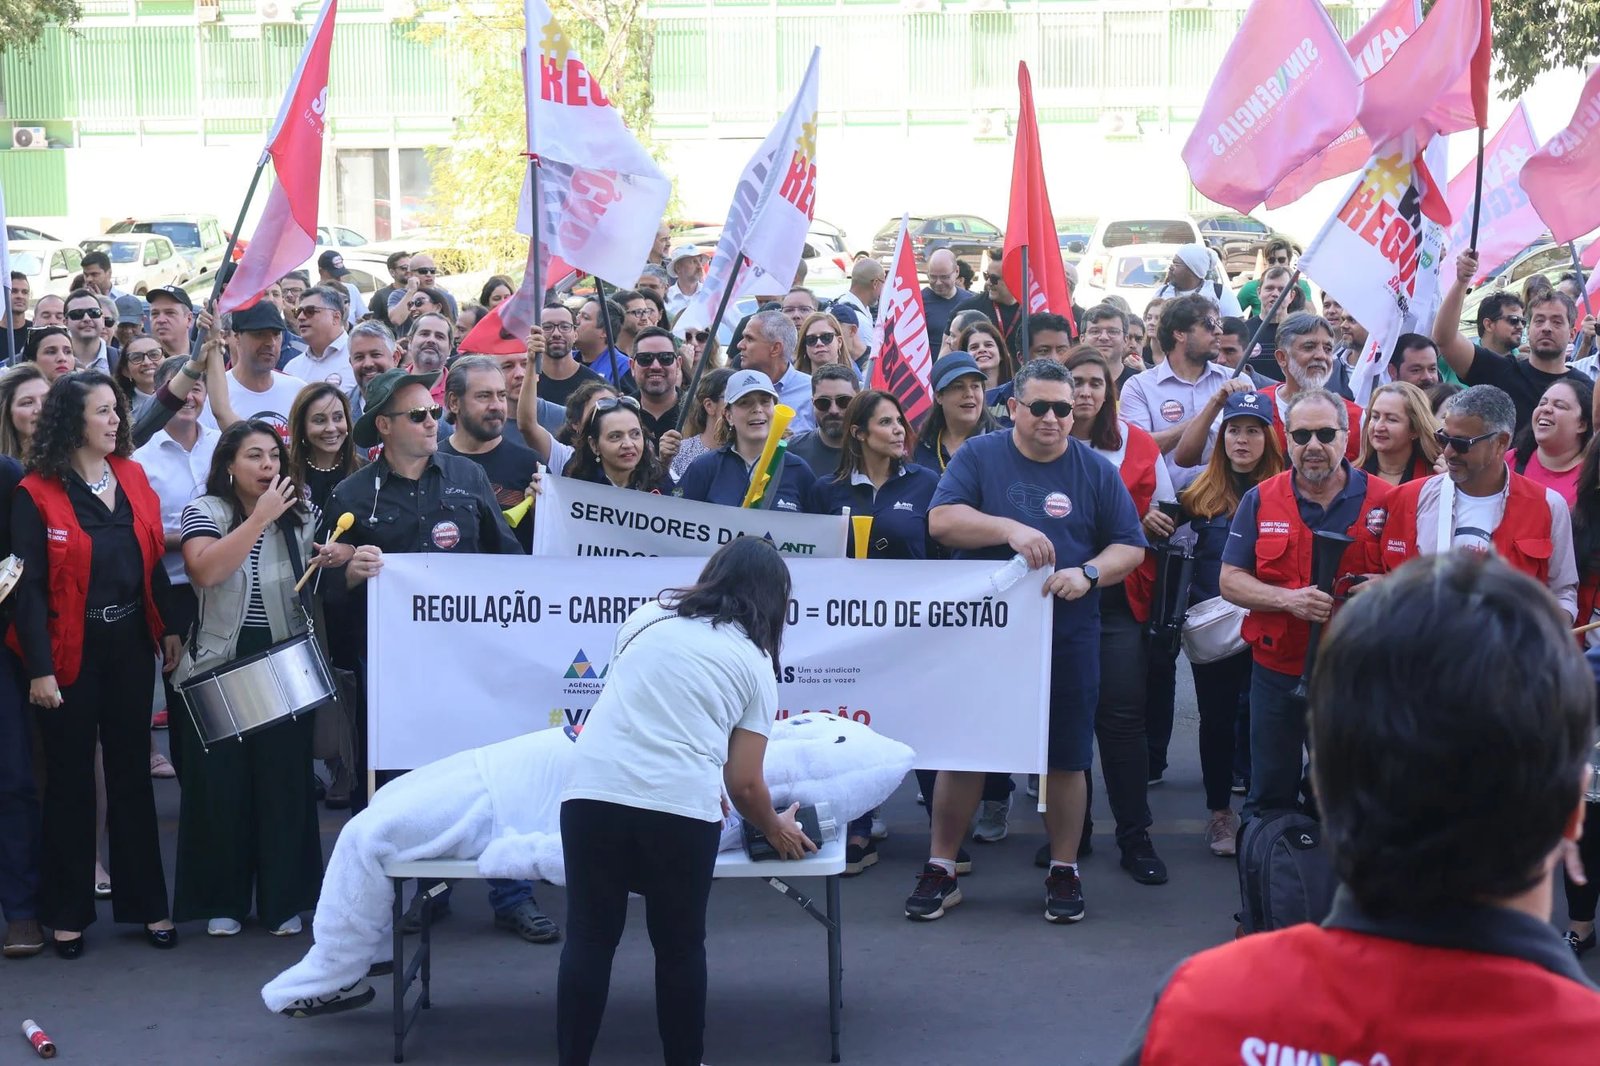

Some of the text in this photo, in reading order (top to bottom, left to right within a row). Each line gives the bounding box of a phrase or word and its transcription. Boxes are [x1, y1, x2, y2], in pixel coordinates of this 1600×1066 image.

[1238, 402, 1260, 410] ANAC
[570, 501, 711, 542] SERVIDORES
[779, 542, 816, 555] ANTT
[412, 590, 541, 628] REGULAÇÃO
[826, 599, 887, 627] CICLO
[894, 600, 922, 628] DE
[928, 596, 1009, 628] GESTÃO
[825, 666, 861, 674] sindicato
[797, 676, 820, 684] Todas
